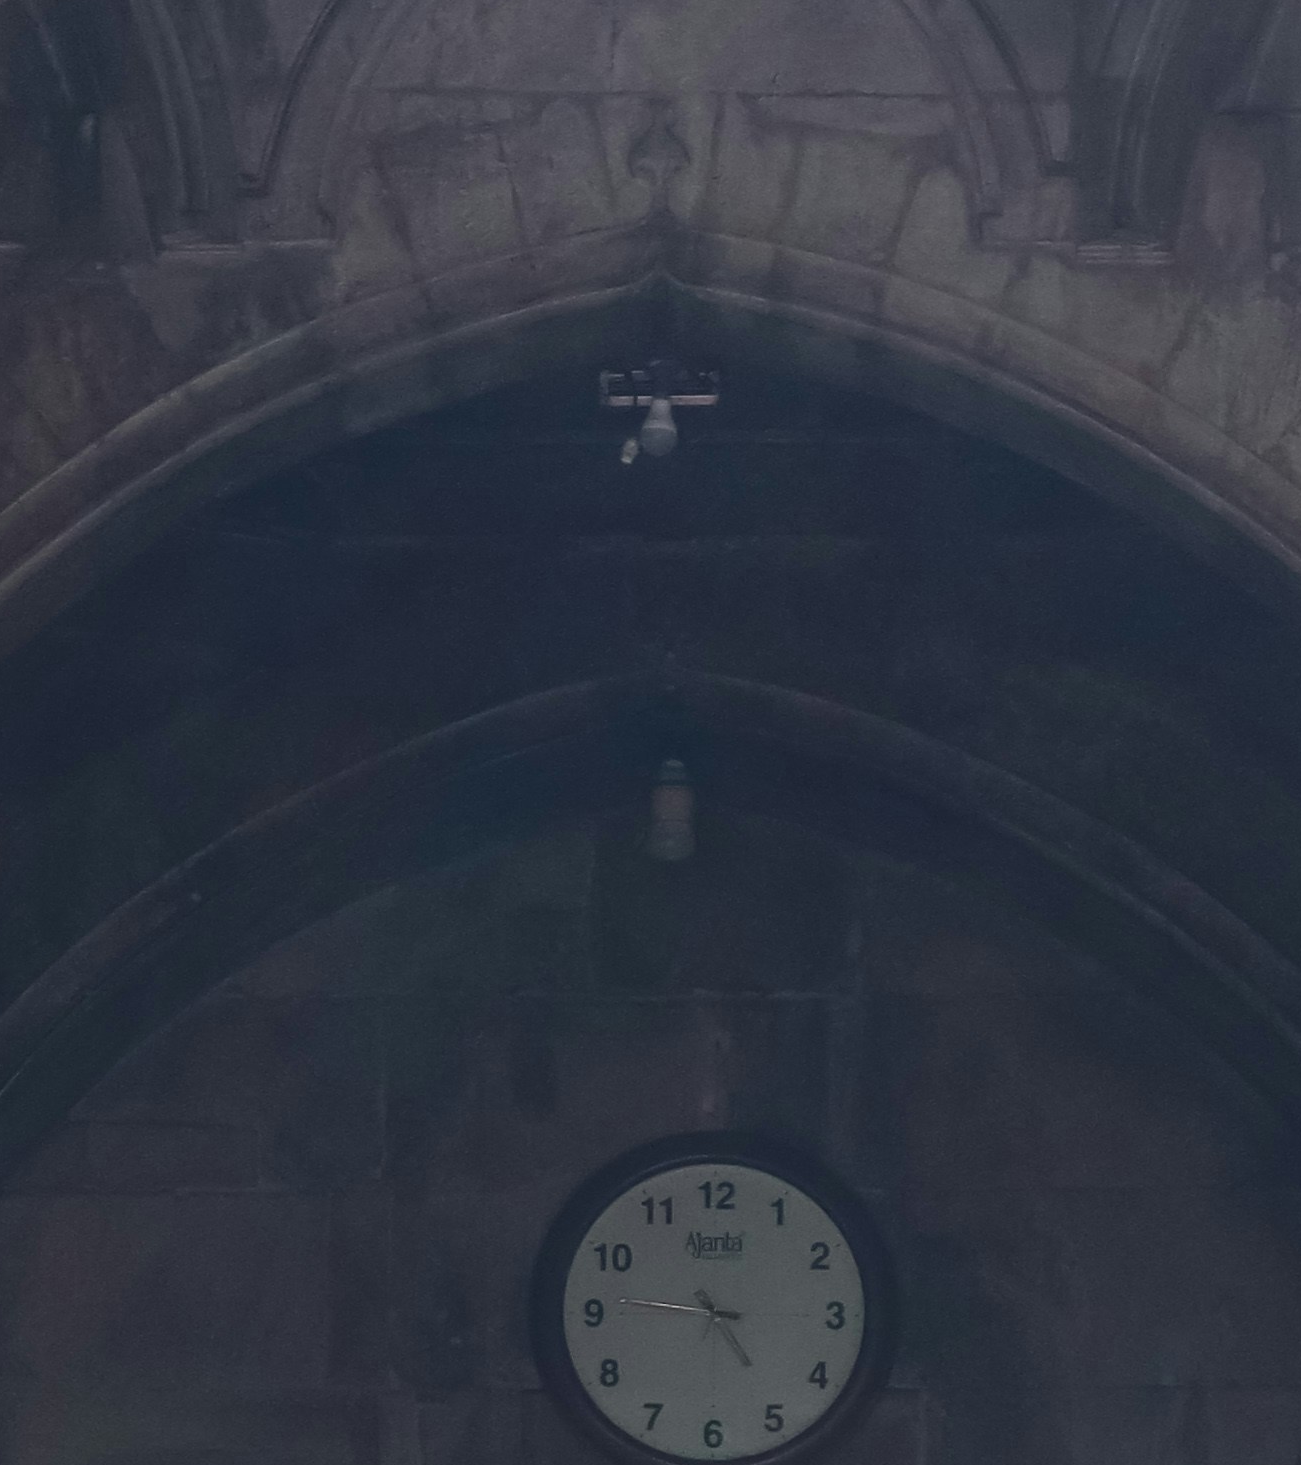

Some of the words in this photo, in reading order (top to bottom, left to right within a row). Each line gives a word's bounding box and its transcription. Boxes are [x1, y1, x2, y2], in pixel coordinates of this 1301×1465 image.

[698, 1181, 736, 1209] 12
[641, 1198, 673, 1224] 11
[771, 1198, 785, 1225] 1
[595, 1243, 632, 1271] 10
[685, 1230, 744, 1259] Ajanta
[810, 1242, 830, 1270] 2
[584, 1299, 604, 1327] 9
[826, 1302, 845, 1329] 3
[600, 1359, 619, 1387] 8
[809, 1362, 828, 1388] 4
[643, 1403, 664, 1430] 7
[764, 1405, 784, 1431] 5
[703, 1421, 723, 1447] 6
